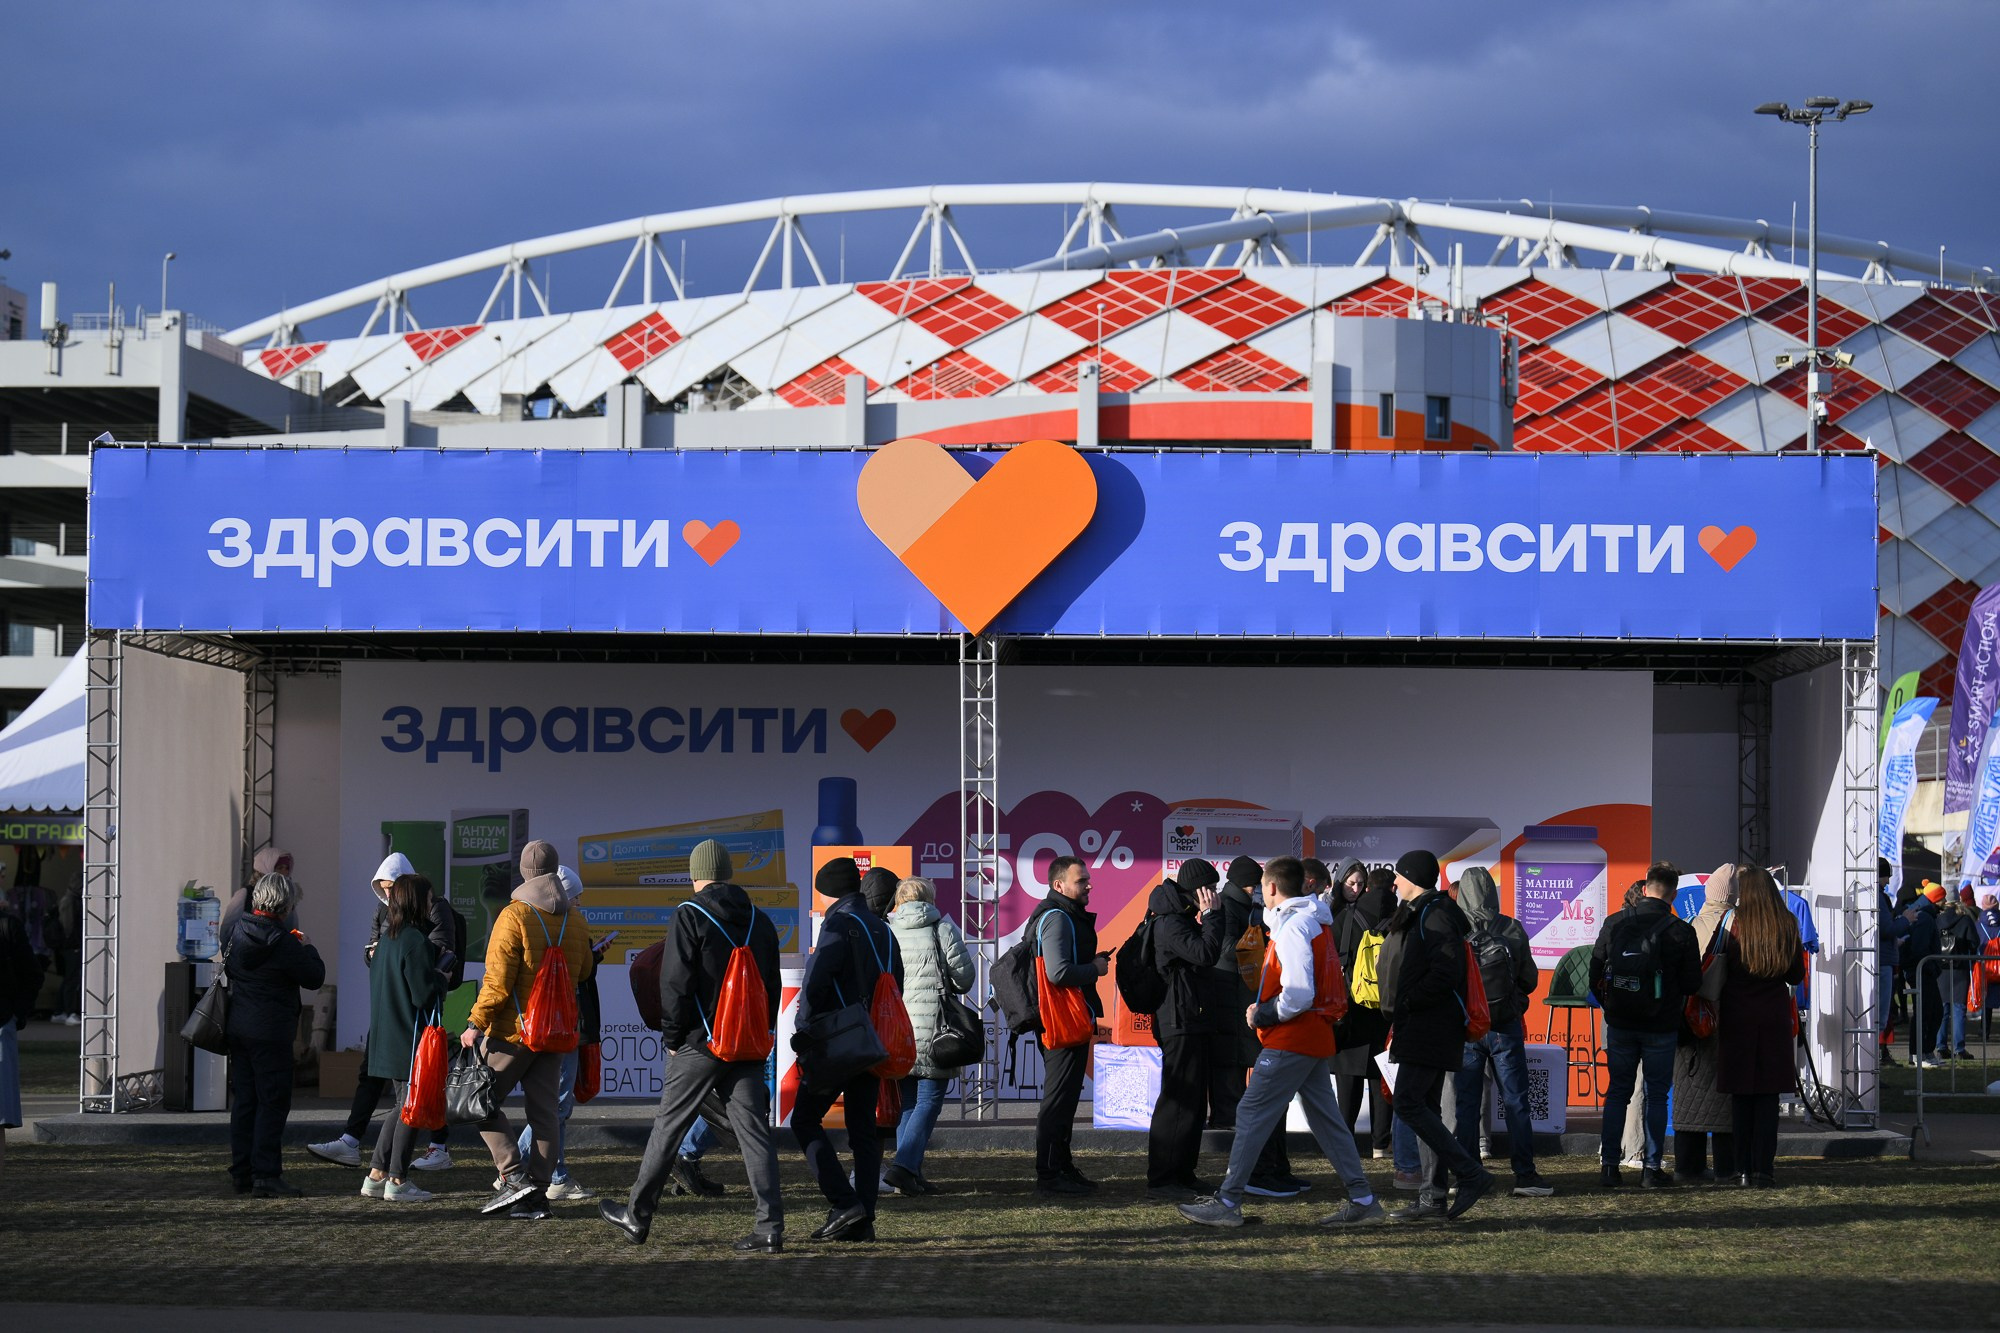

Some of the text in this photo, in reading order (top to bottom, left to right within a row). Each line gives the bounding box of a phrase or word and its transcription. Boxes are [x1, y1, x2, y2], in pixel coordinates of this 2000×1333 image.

[207, 517, 669, 588] здравсити
[1218, 521, 1685, 593] здравсити
[1968, 611, 1998, 730] SMART ACTION
[381, 706, 827, 772] здравсити
[456, 825, 506, 837] ТАНТУМ
[461, 837, 500, 850] ВЕРДЕ
[1170, 836, 1199, 848] Doppel
[1215, 835, 1242, 846] V.I.P.
[920, 842, 954, 861] ДО
[1176, 843, 1194, 852] herz
[1166, 859, 1219, 870] ENY
[1525, 878, 1573, 888] МАГНИЙ
[453, 897, 475, 905] СПРЕЙ
[1525, 891, 1562, 899] ХЕЛАТ
[1560, 899, 1594, 924] Mg
[601, 1022, 654, 1035] .protek.
